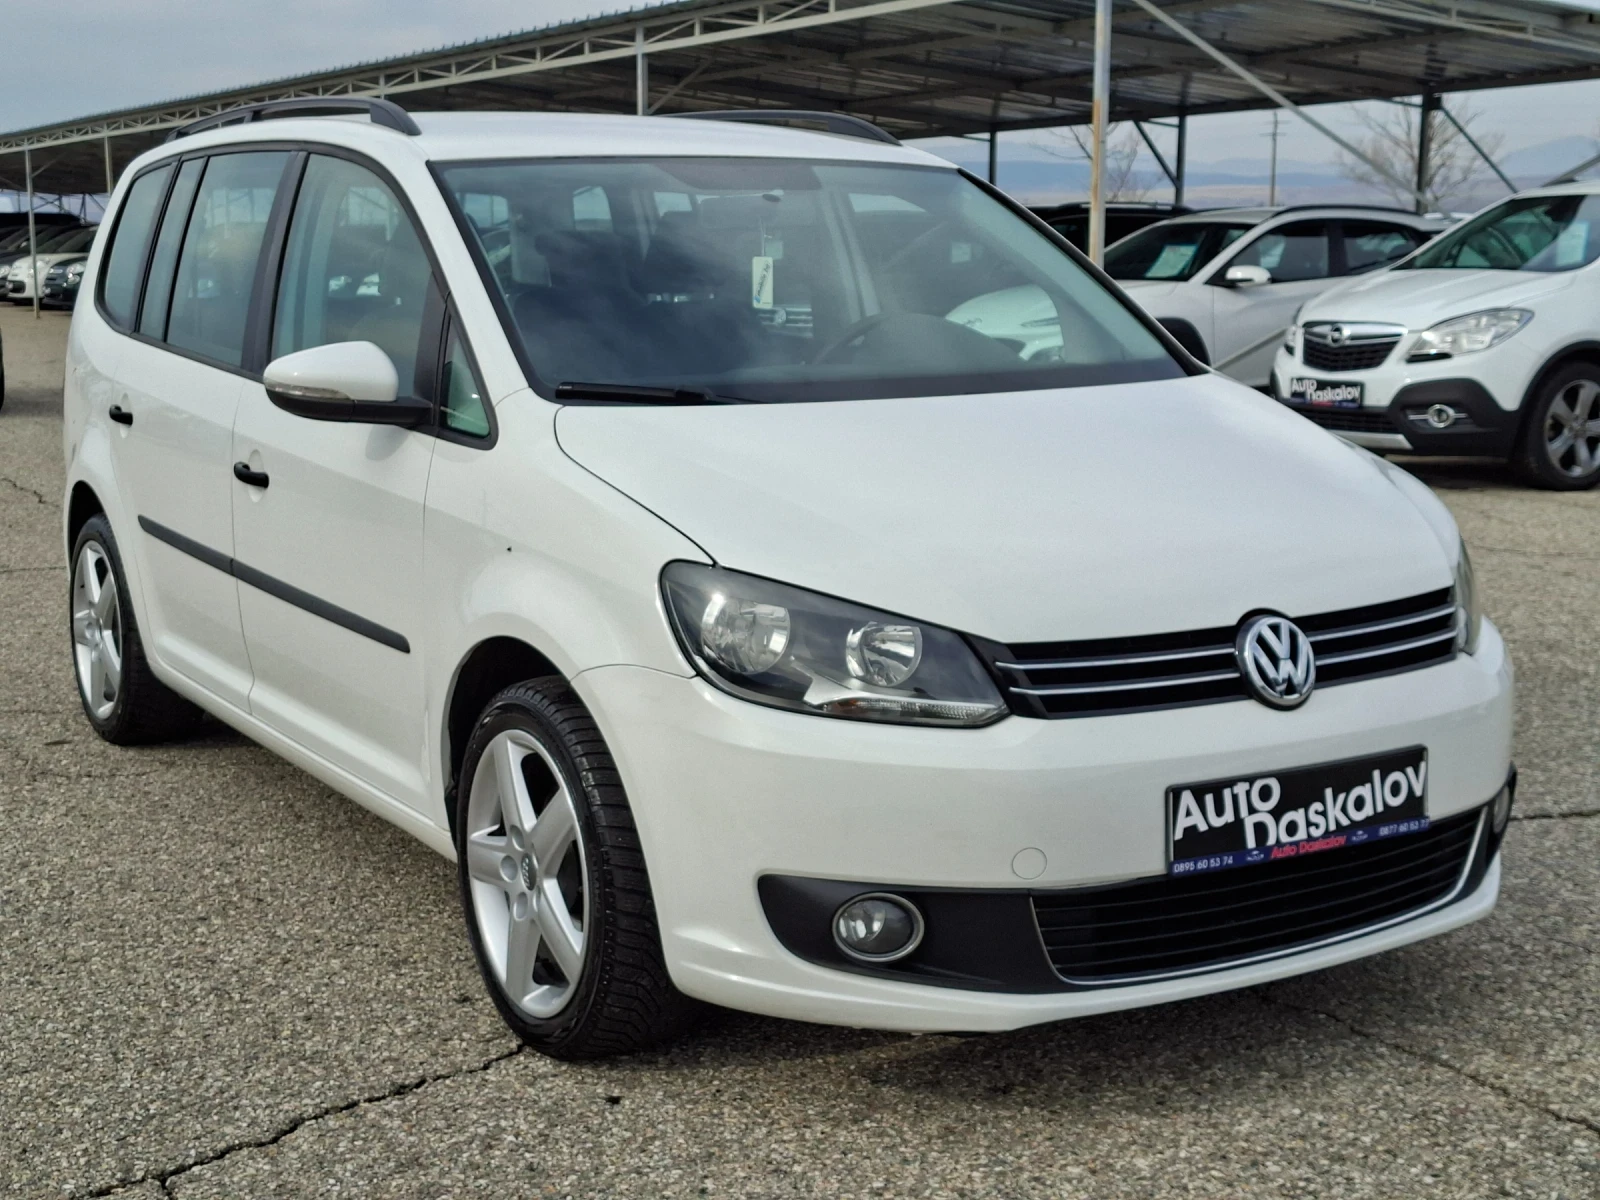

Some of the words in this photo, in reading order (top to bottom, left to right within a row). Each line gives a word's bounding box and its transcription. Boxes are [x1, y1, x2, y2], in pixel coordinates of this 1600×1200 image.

[1244, 761, 1427, 849] Daskalov
[1271, 844, 1297, 859] Auto
[1299, 835, 1347, 854] Daskalov
[1173, 861, 1195, 873] 0895
[1196, 859, 1208, 870] 60
[1209, 857, 1220, 868] 53
[1222, 855, 1233, 865] 74
